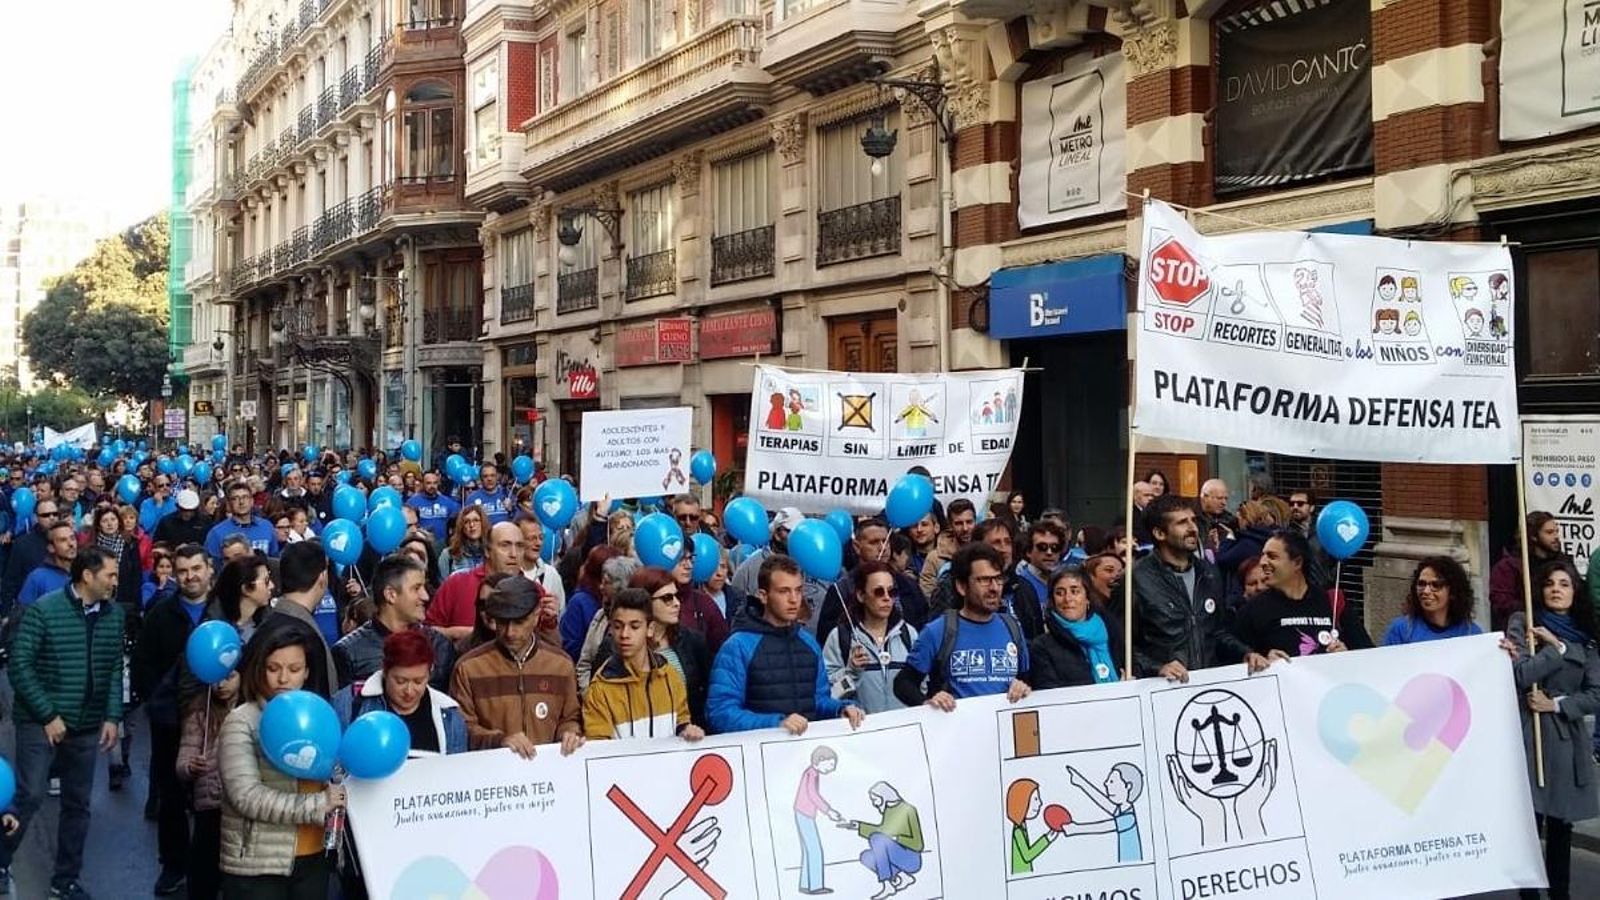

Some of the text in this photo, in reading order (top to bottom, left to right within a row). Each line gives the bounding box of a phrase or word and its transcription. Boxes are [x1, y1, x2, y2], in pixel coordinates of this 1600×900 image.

[1060, 135, 1093, 153] METRO
[1059, 149, 1093, 168] LINEAL
[1151, 257, 1208, 287] STOP
[1155, 311, 1195, 333] STOP
[1213, 321, 1277, 347] RECORTES
[1356, 339, 1374, 359] los
[1380, 344, 1430, 362] NIÑOS
[1435, 346, 1464, 357] con
[1466, 342, 1506, 354] DIVERSIDAD
[1466, 354, 1506, 365] FUNCIONAL
[571, 375, 595, 396] illy
[1154, 370, 1502, 429] PLATAFORMA DEFENSA TEA
[601, 424, 658, 434] ADOLESCENTES
[643, 436, 660, 444] CON
[759, 436, 819, 451] TERAPIAS
[843, 443, 869, 455] SIN
[948, 442, 965, 453] DE
[981, 438, 1010, 450] EDAD
[636, 448, 651, 456] LOS
[758, 471, 888, 497] PLATAFORMA
[933, 474, 982, 494] ENSA
[1559, 523, 1595, 540] TRO
[394, 781, 555, 811] PLATAFORMA DEFENSA TEA
[1339, 833, 1486, 864] PLATAFORMA DEFENSA TEA
[1181, 861, 1301, 900] DERECHOS
